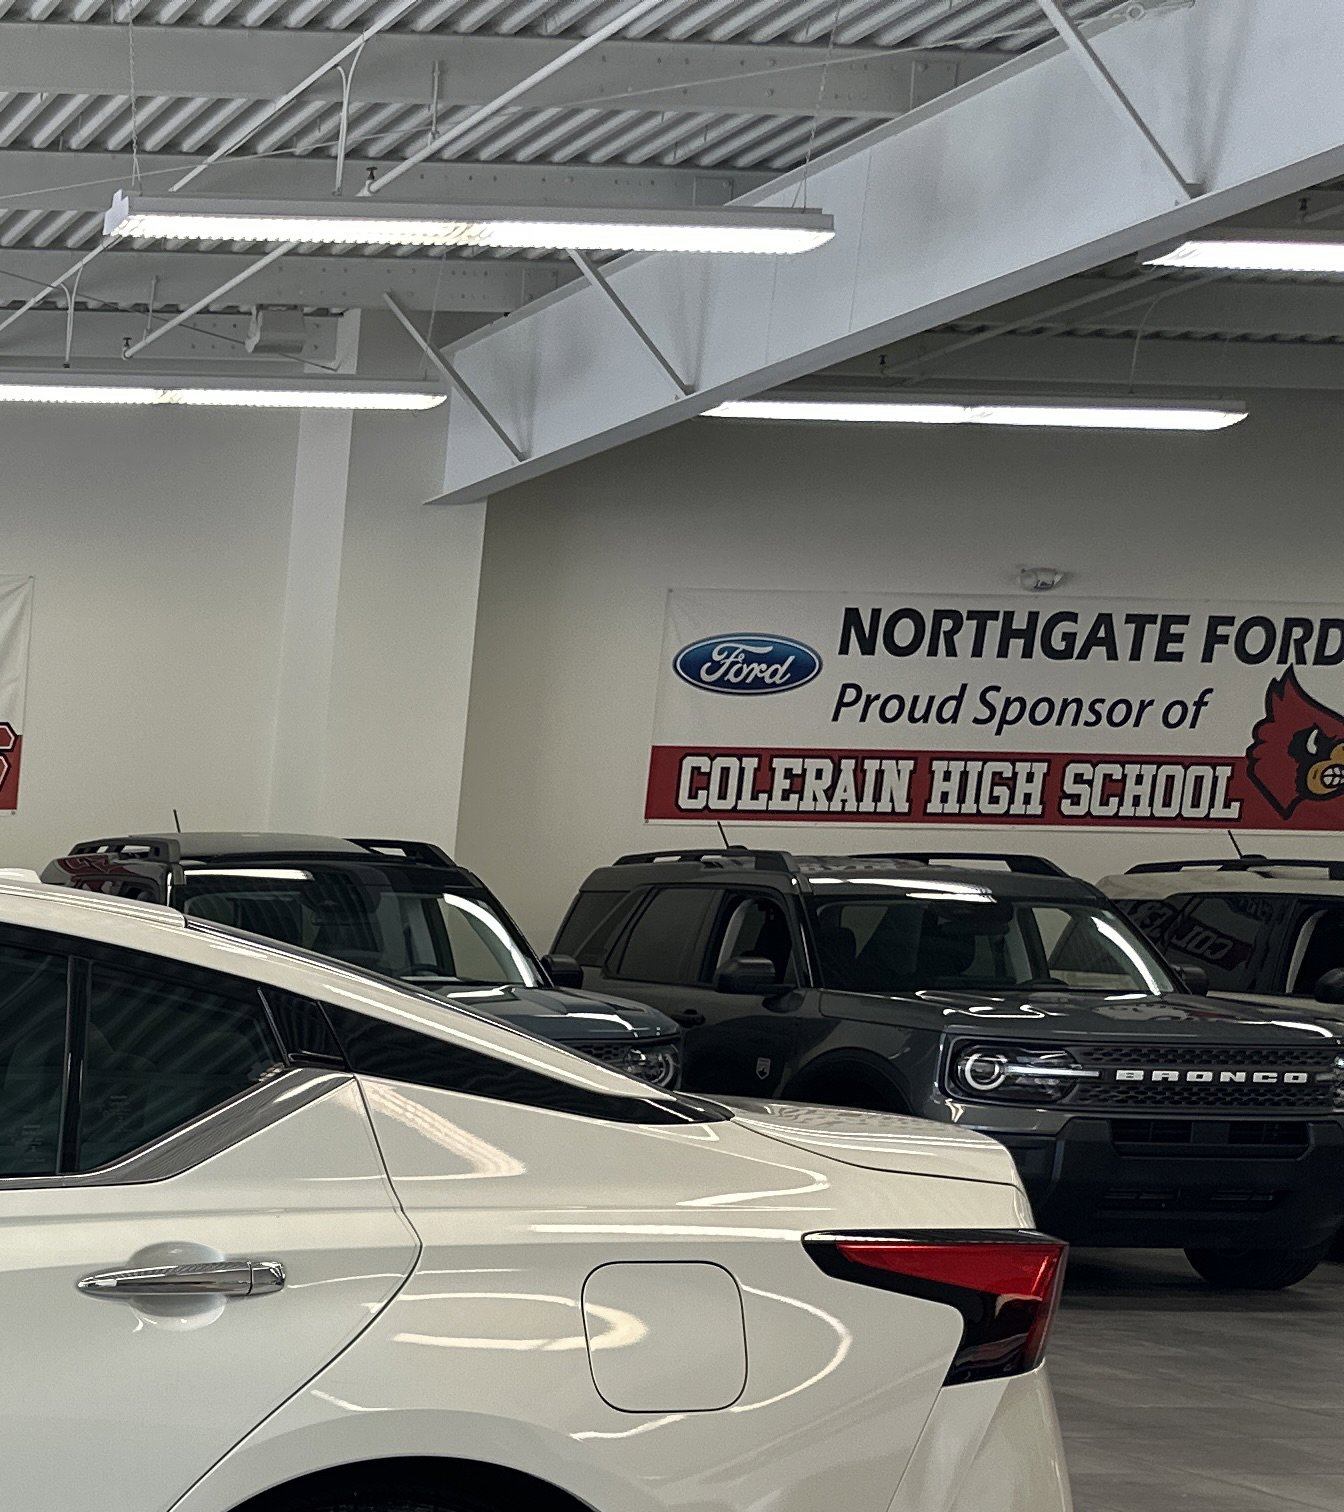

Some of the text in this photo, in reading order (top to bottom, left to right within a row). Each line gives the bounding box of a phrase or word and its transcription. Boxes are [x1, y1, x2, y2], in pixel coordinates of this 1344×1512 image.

[709, 640, 795, 686] Ford
[837, 606, 1344, 666] NORTHGATE FORD
[831, 682, 1214, 737] Proud Sponsor of
[675, 754, 1243, 821] COLERAIN HIGH SCHOOL
[1115, 1069, 1308, 1083] BRONCO
